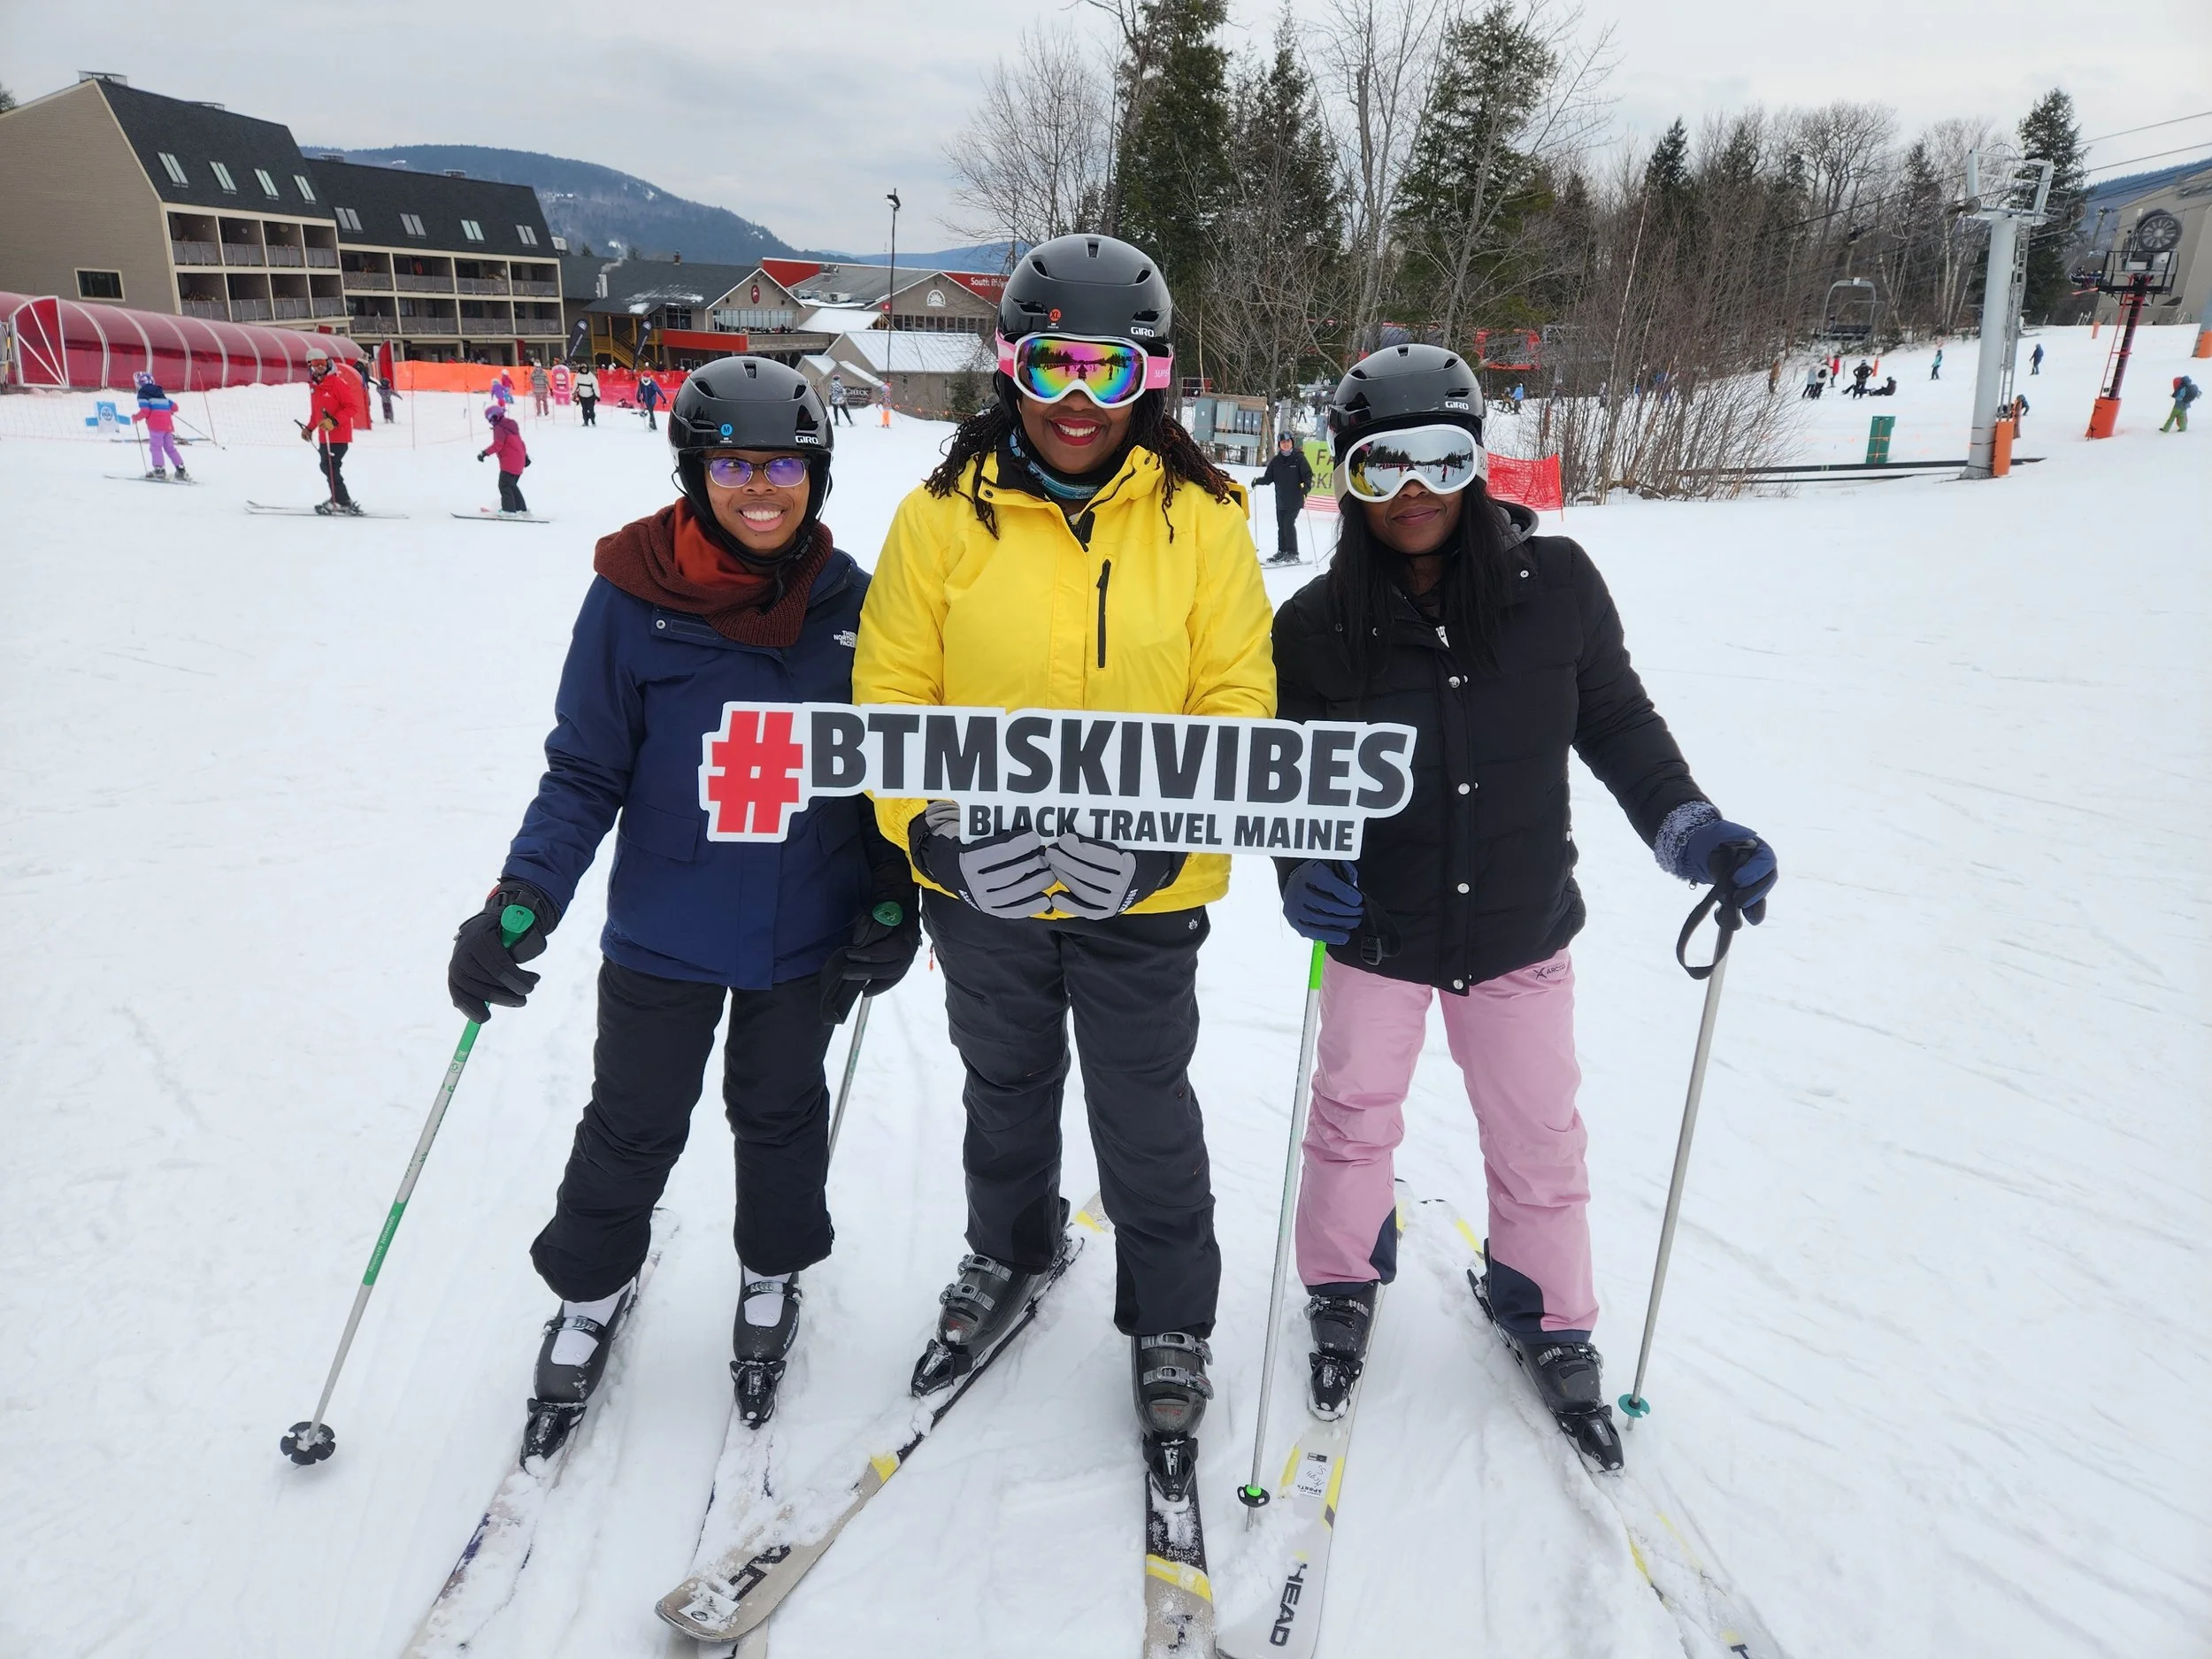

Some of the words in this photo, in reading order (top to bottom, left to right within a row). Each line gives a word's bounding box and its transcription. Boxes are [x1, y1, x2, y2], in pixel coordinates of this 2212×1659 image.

[971, 276, 990, 287] South
[1131, 326, 1155, 337] GIRO
[1445, 401, 1469, 411] GIRO
[795, 435, 818, 445] GIRO
[708, 710, 1408, 833] #BTMSKIVIBES
[969, 804, 1079, 837] BLACK
[1089, 809, 1222, 845] TRAVEL
[1233, 815, 1355, 851] MAINE
[1270, 1563, 1308, 1647] HEAD
